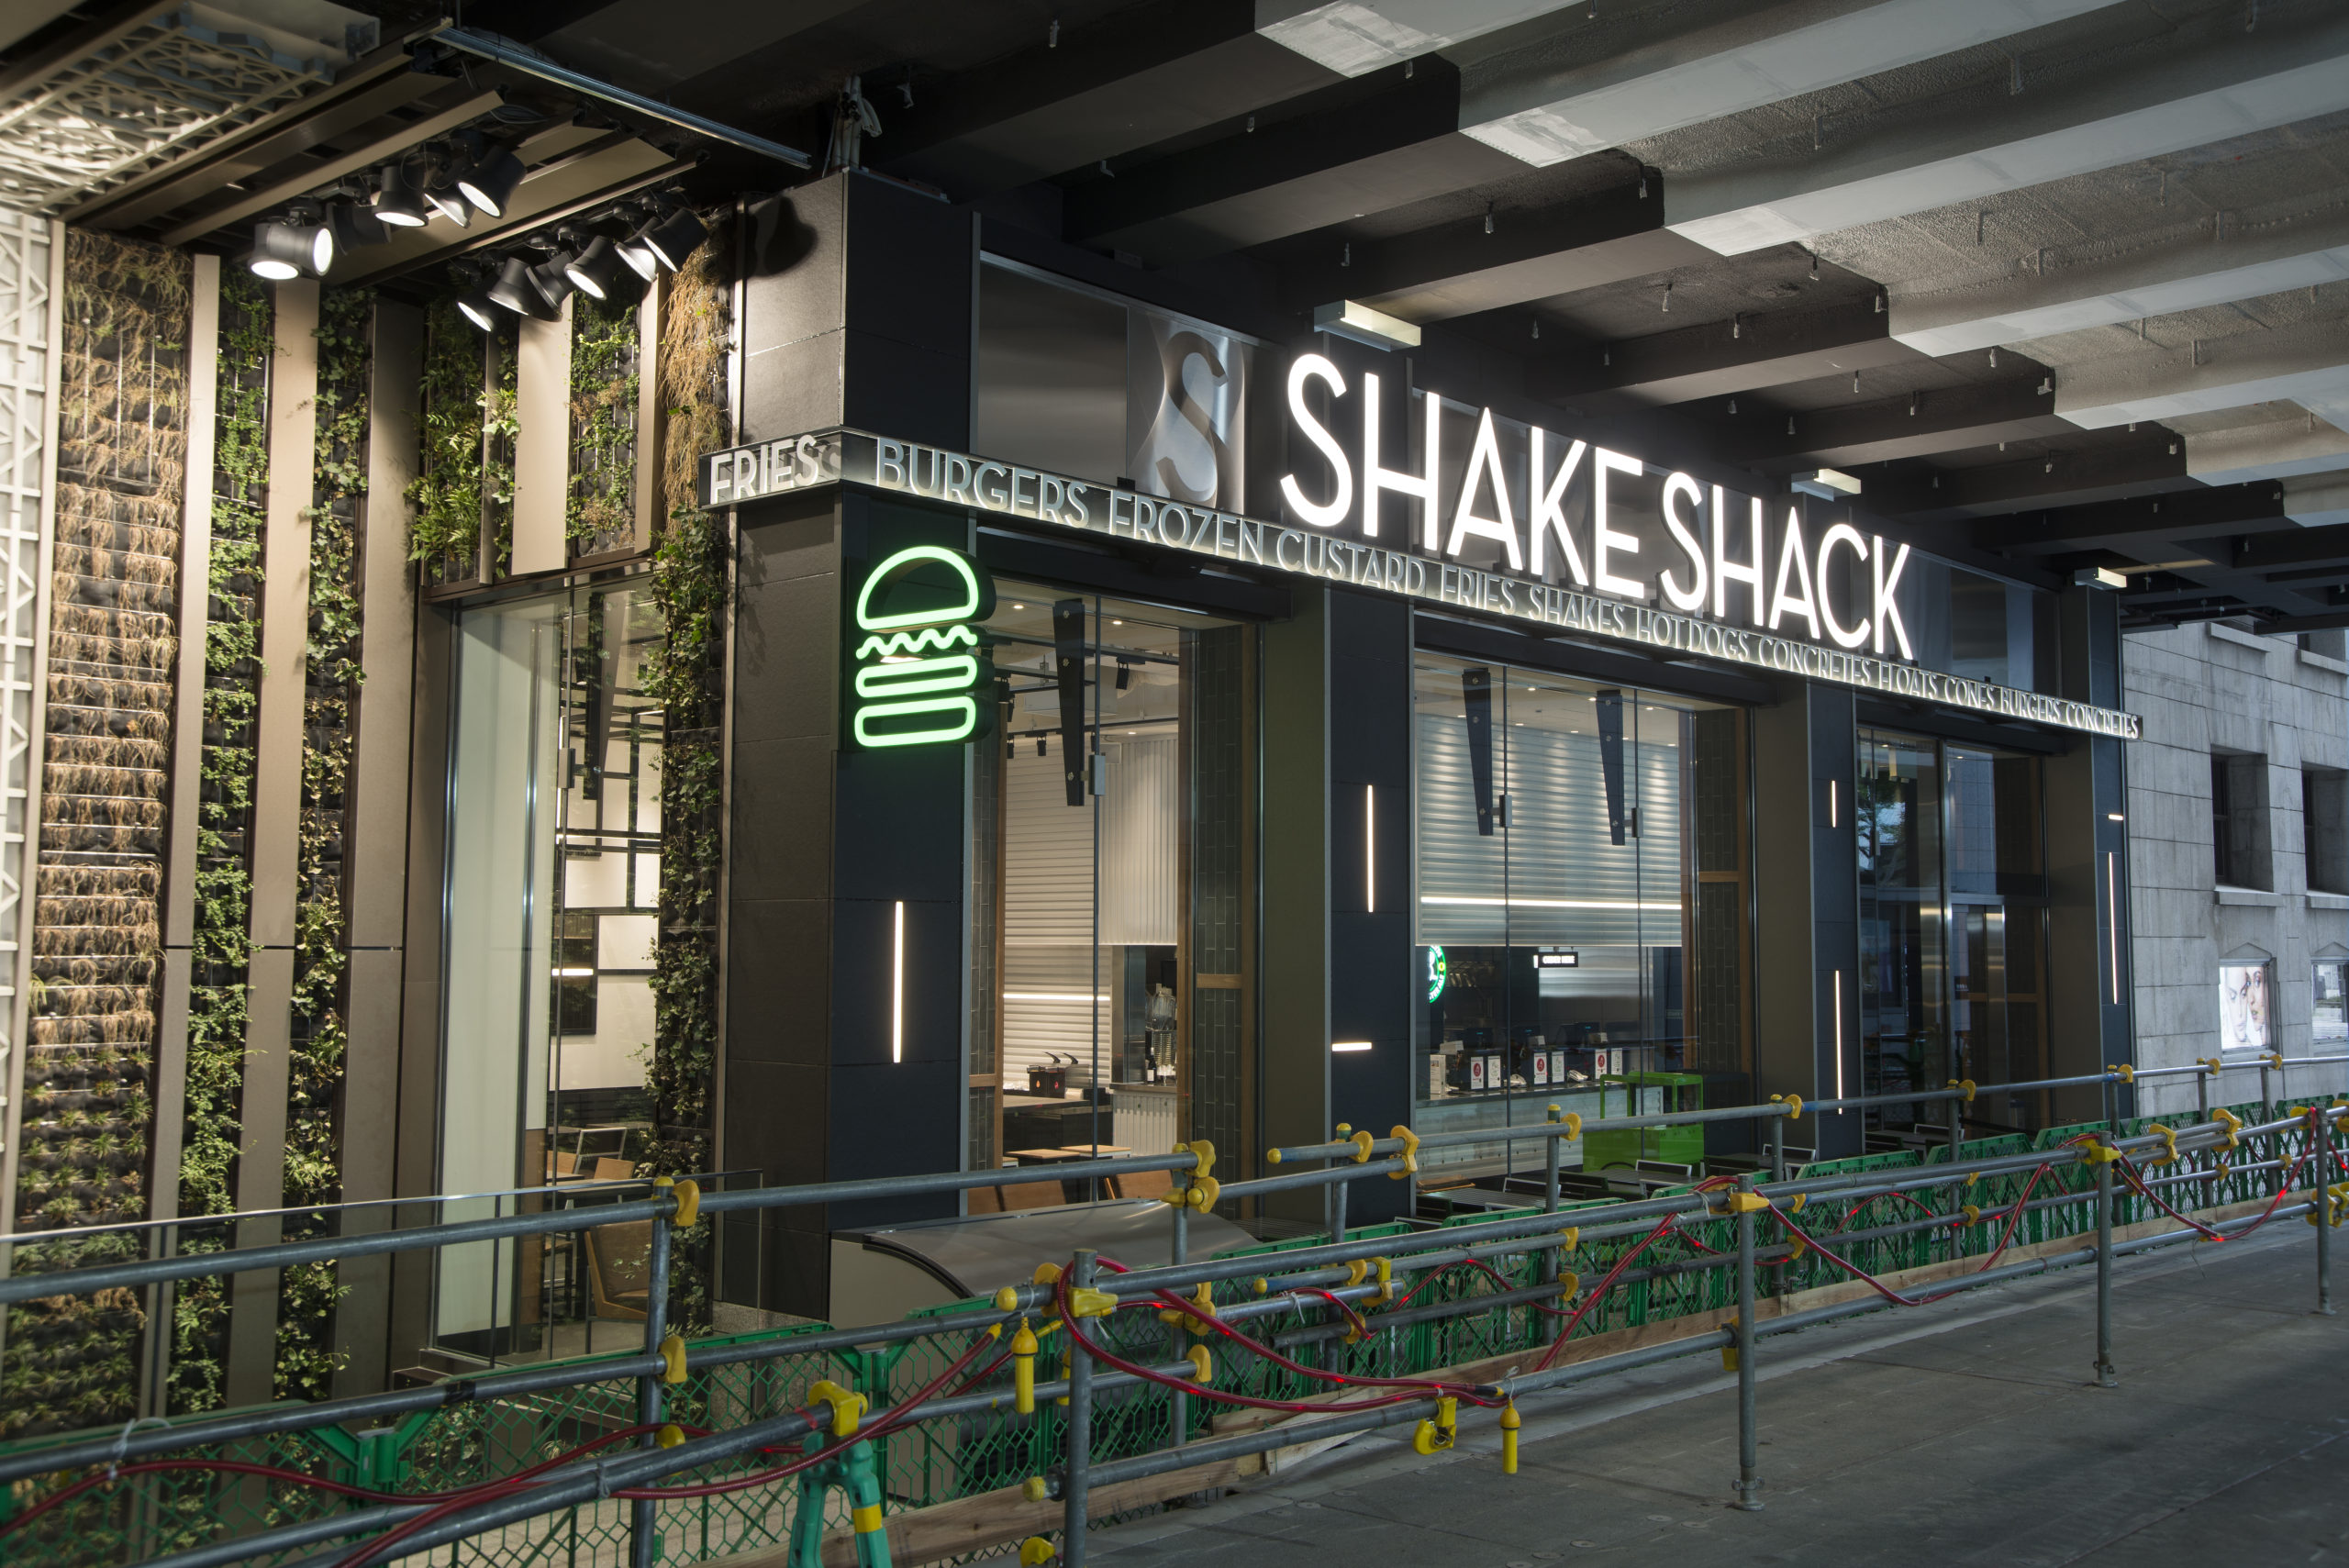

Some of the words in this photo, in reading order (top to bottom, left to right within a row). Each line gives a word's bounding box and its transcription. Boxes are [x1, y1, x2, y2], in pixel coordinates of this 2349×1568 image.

[709, 434, 818, 504] FRIES
[876, 437, 1089, 528] BURGERS
[1109, 490, 1264, 565] FROZEN
[1276, 528, 1426, 595] CUSTARD
[1441, 563, 1516, 615] FRIES
[1529, 584, 1625, 639] SHAKES
[1636, 606, 1685, 648] HOT
[1687, 617, 1749, 662] DOGS
[1759, 635, 1871, 686] CONCRETES
[1878, 660, 1938, 700] FLOATS
[1943, 676, 1995, 710] CONES
[2001, 686, 2062, 723] BURGERS
[2065, 702, 2139, 740] CONCRETES
[1280, 354, 1644, 598] SHAKE
[1657, 470, 1914, 661] SHACK
